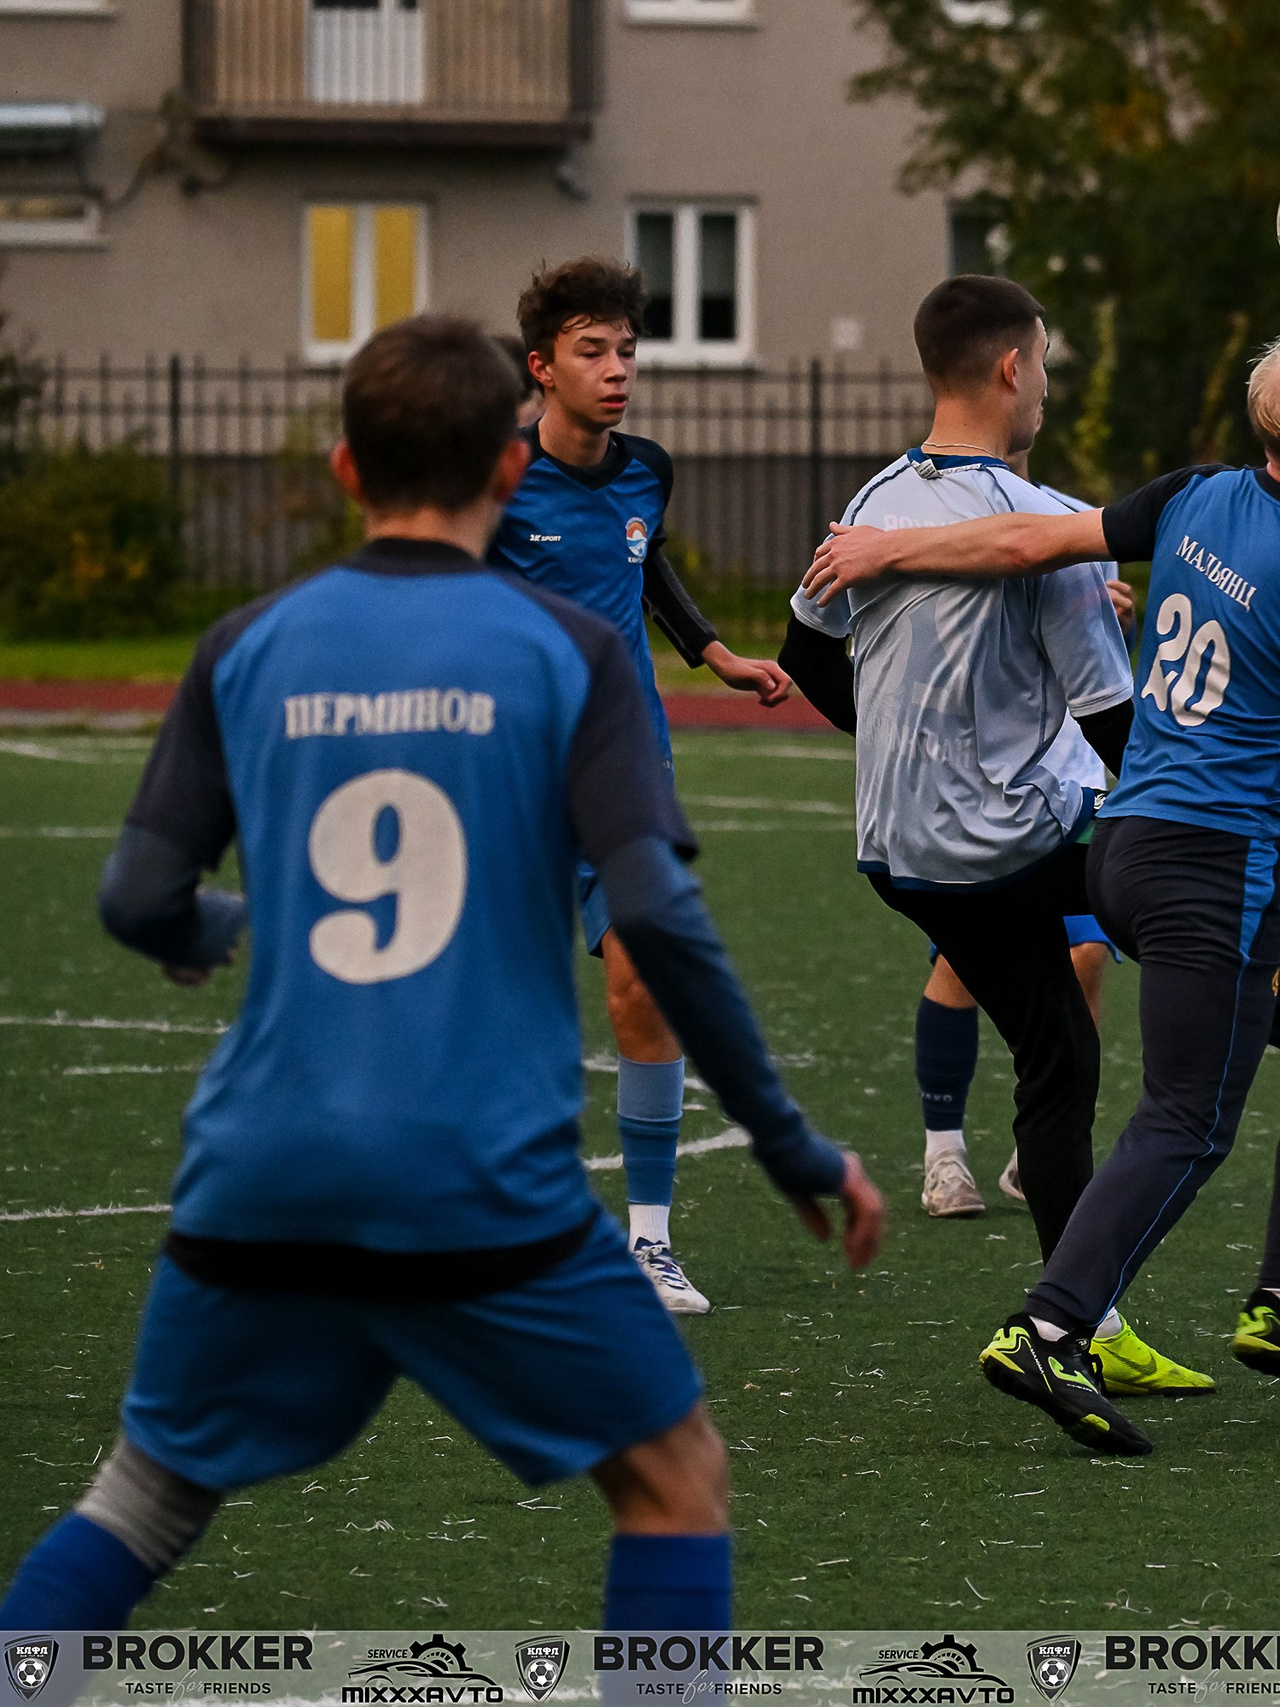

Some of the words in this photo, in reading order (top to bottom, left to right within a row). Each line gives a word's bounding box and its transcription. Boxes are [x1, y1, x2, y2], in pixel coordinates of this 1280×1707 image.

[1175, 535, 1257, 612] МАЛЬЯНЦ
[1140, 593, 1231, 727] 20
[284, 687, 496, 739] ПЕРМИНОВ
[308, 767, 468, 985] 9
